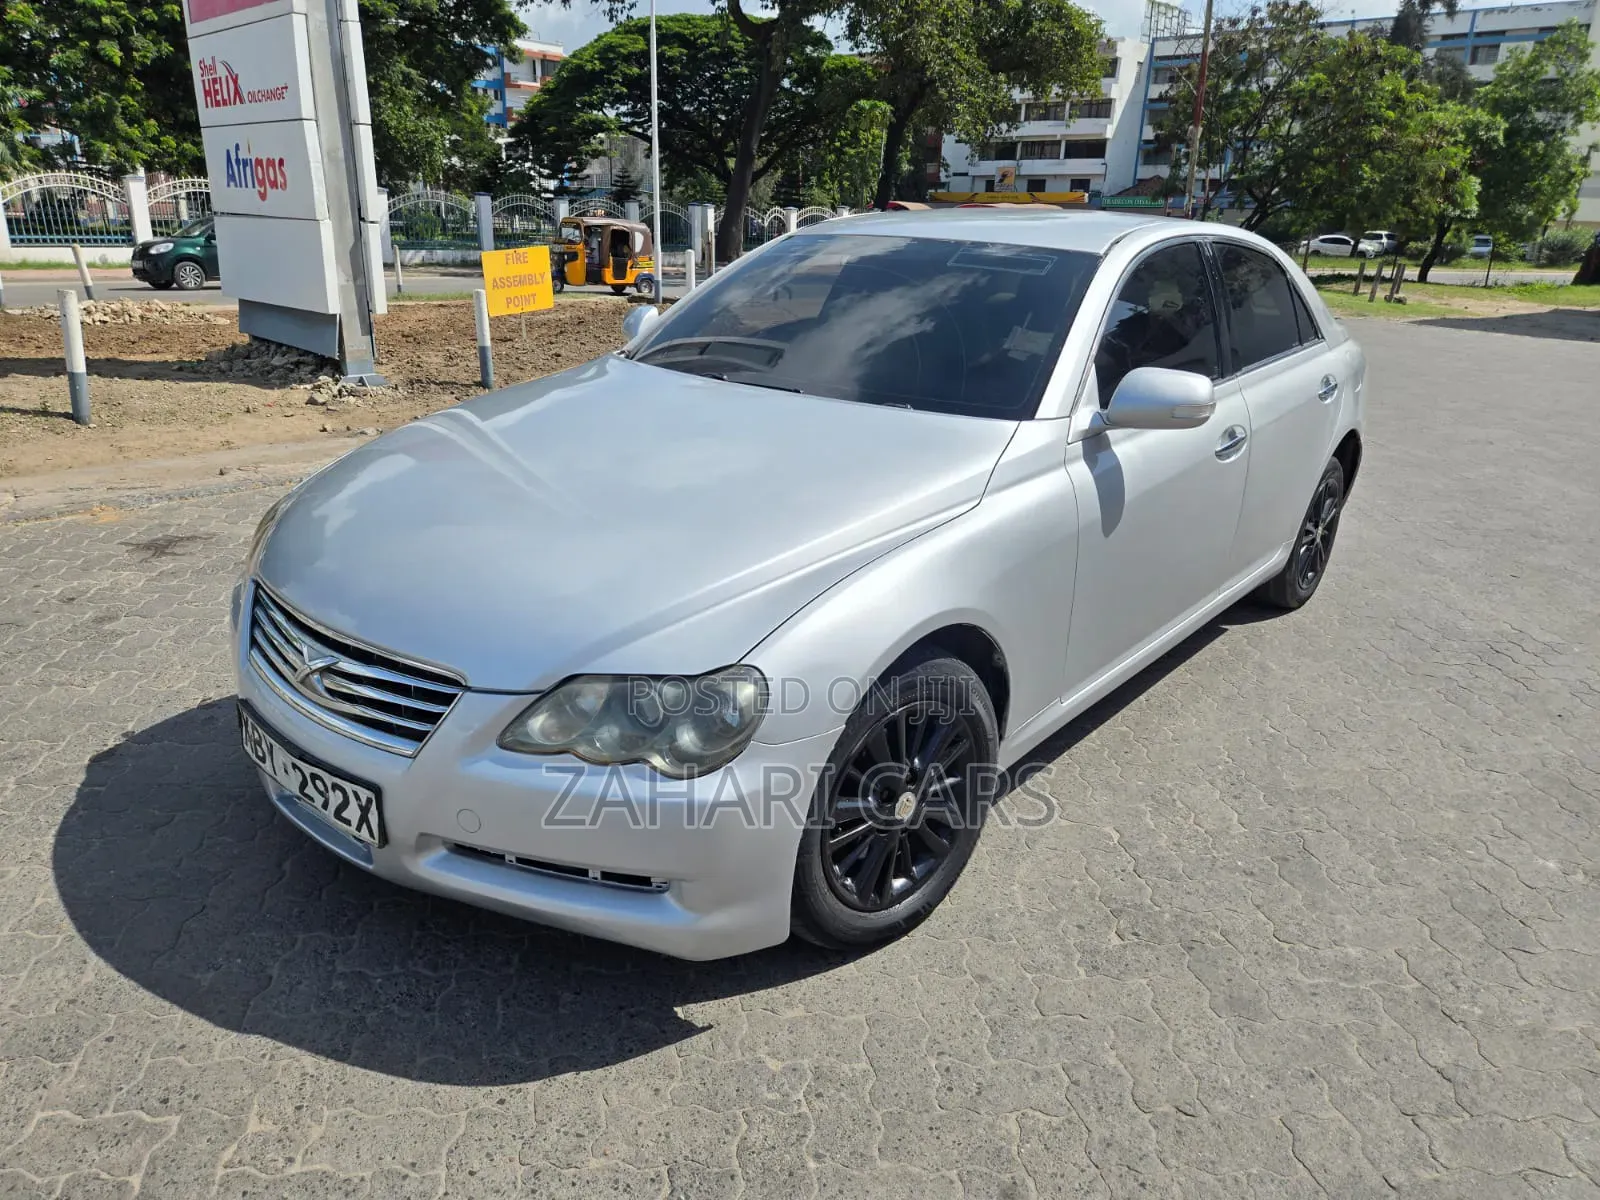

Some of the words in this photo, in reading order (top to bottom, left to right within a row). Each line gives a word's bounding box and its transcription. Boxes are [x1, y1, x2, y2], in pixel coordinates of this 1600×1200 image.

[199, 56, 218, 77] Shell
[201, 72, 246, 109] HELIX
[226, 141, 287, 201] Afrigas
[505, 252, 529, 265] FIRE
[492, 272, 546, 290] ASSEMBLY
[505, 292, 537, 309] POINT
[291, 762, 376, 840] 292X
